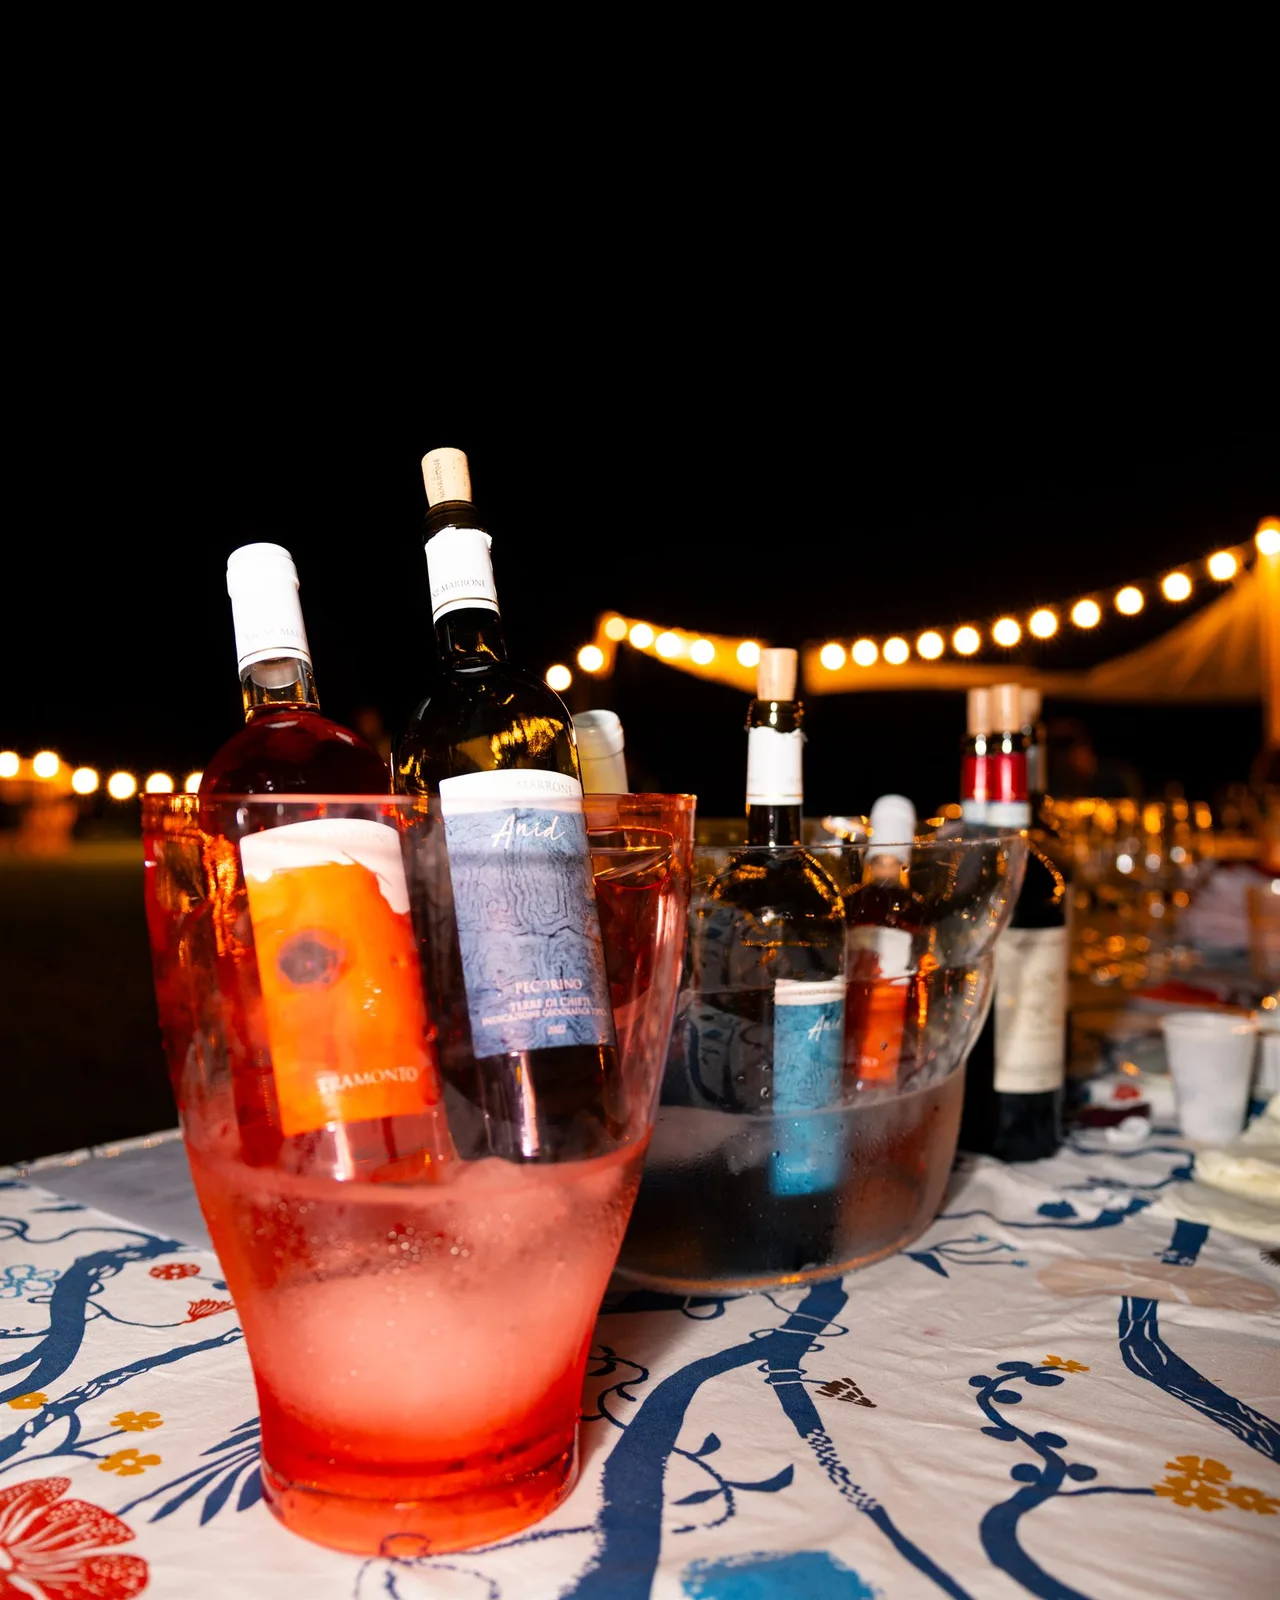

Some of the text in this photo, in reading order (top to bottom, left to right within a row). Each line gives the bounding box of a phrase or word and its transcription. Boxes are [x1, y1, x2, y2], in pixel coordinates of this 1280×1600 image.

[441, 578, 487, 592] MARRONE
[516, 779, 574, 797] MARRONE
[490, 814, 565, 850] Anid
[515, 978, 583, 994] PECORINO
[316, 1066, 419, 1095] TRAMONTO
